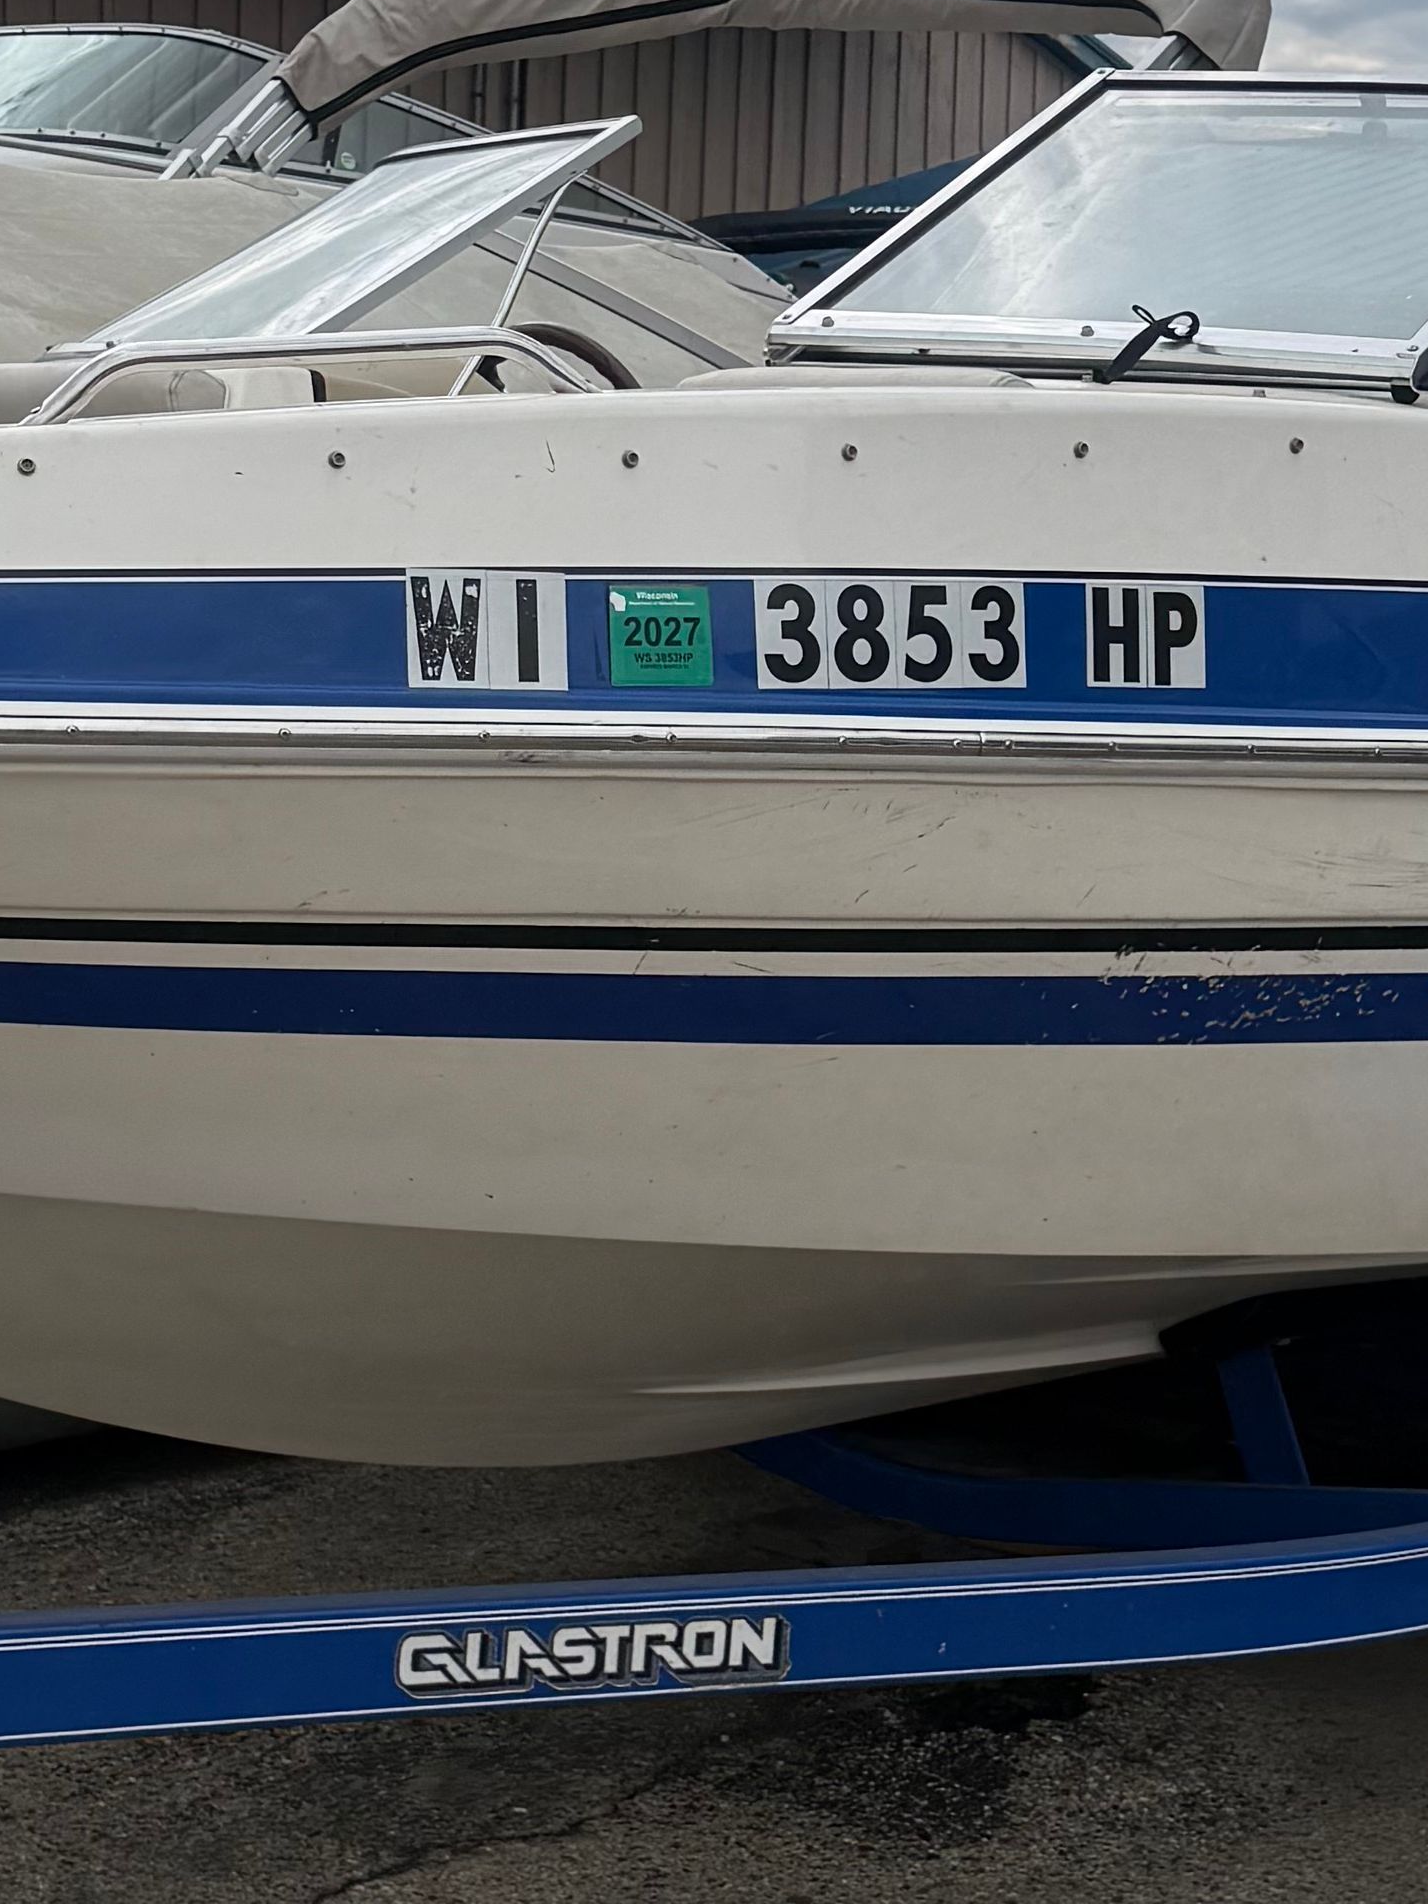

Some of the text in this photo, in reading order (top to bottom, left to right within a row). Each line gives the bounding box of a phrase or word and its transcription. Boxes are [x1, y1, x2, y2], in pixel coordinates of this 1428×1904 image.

[410, 576, 1198, 686] WI 3853 HP
[624, 617, 701, 647] 2027
[399, 1616, 787, 1694] GLASTRON
